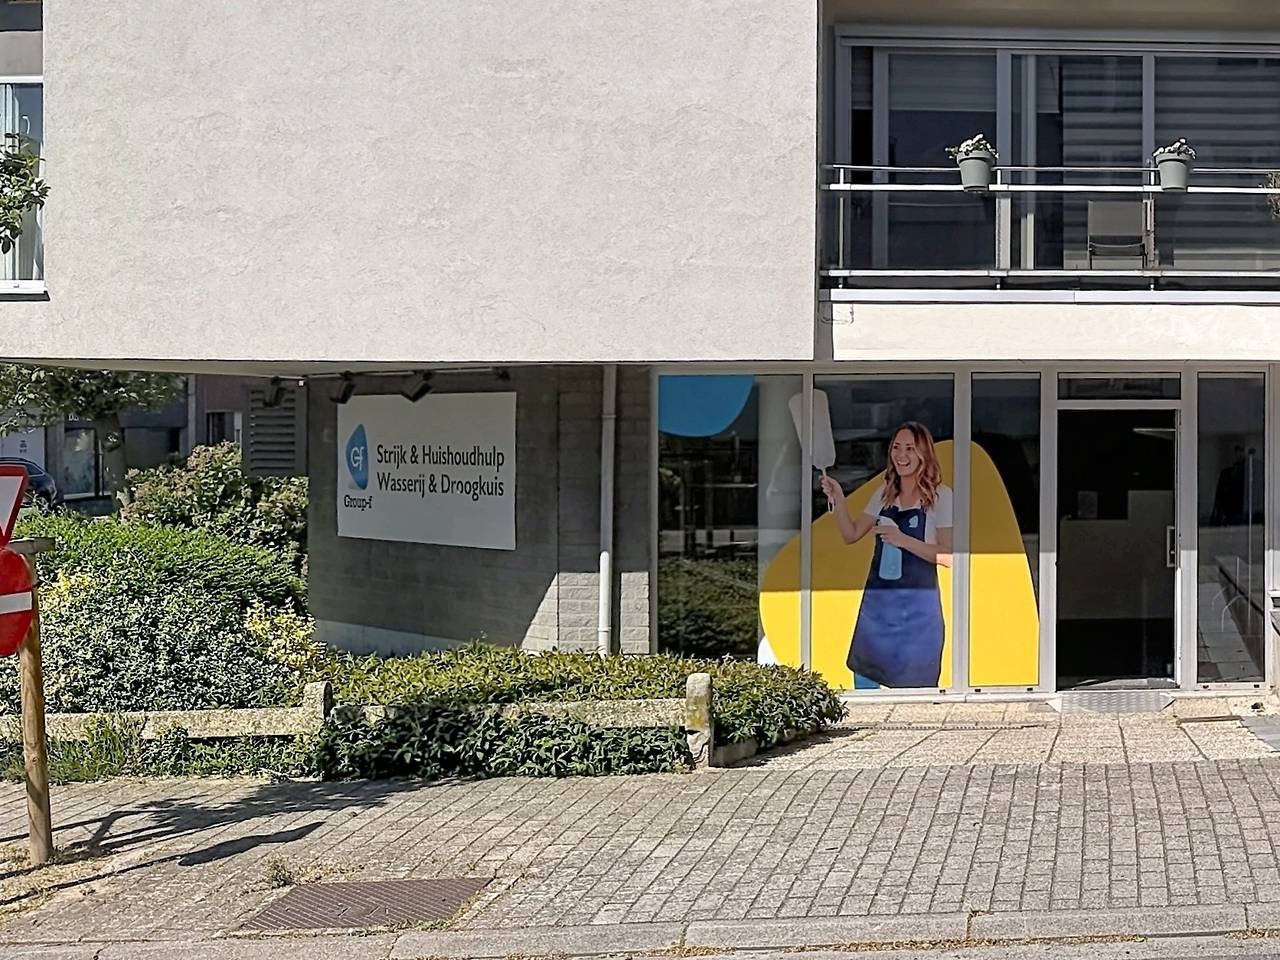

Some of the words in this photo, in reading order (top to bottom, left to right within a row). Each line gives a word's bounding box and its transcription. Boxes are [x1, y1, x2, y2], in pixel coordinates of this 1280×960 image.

[376, 444, 407, 469] Strijk
[409, 444, 419, 465] &
[422, 444, 505, 473] Huishoudhulp
[376, 472, 425, 498] Wasserij
[428, 474, 438, 493] &
[441, 474, 505, 502] Droogkuis
[344, 494, 373, 511] Group-f
